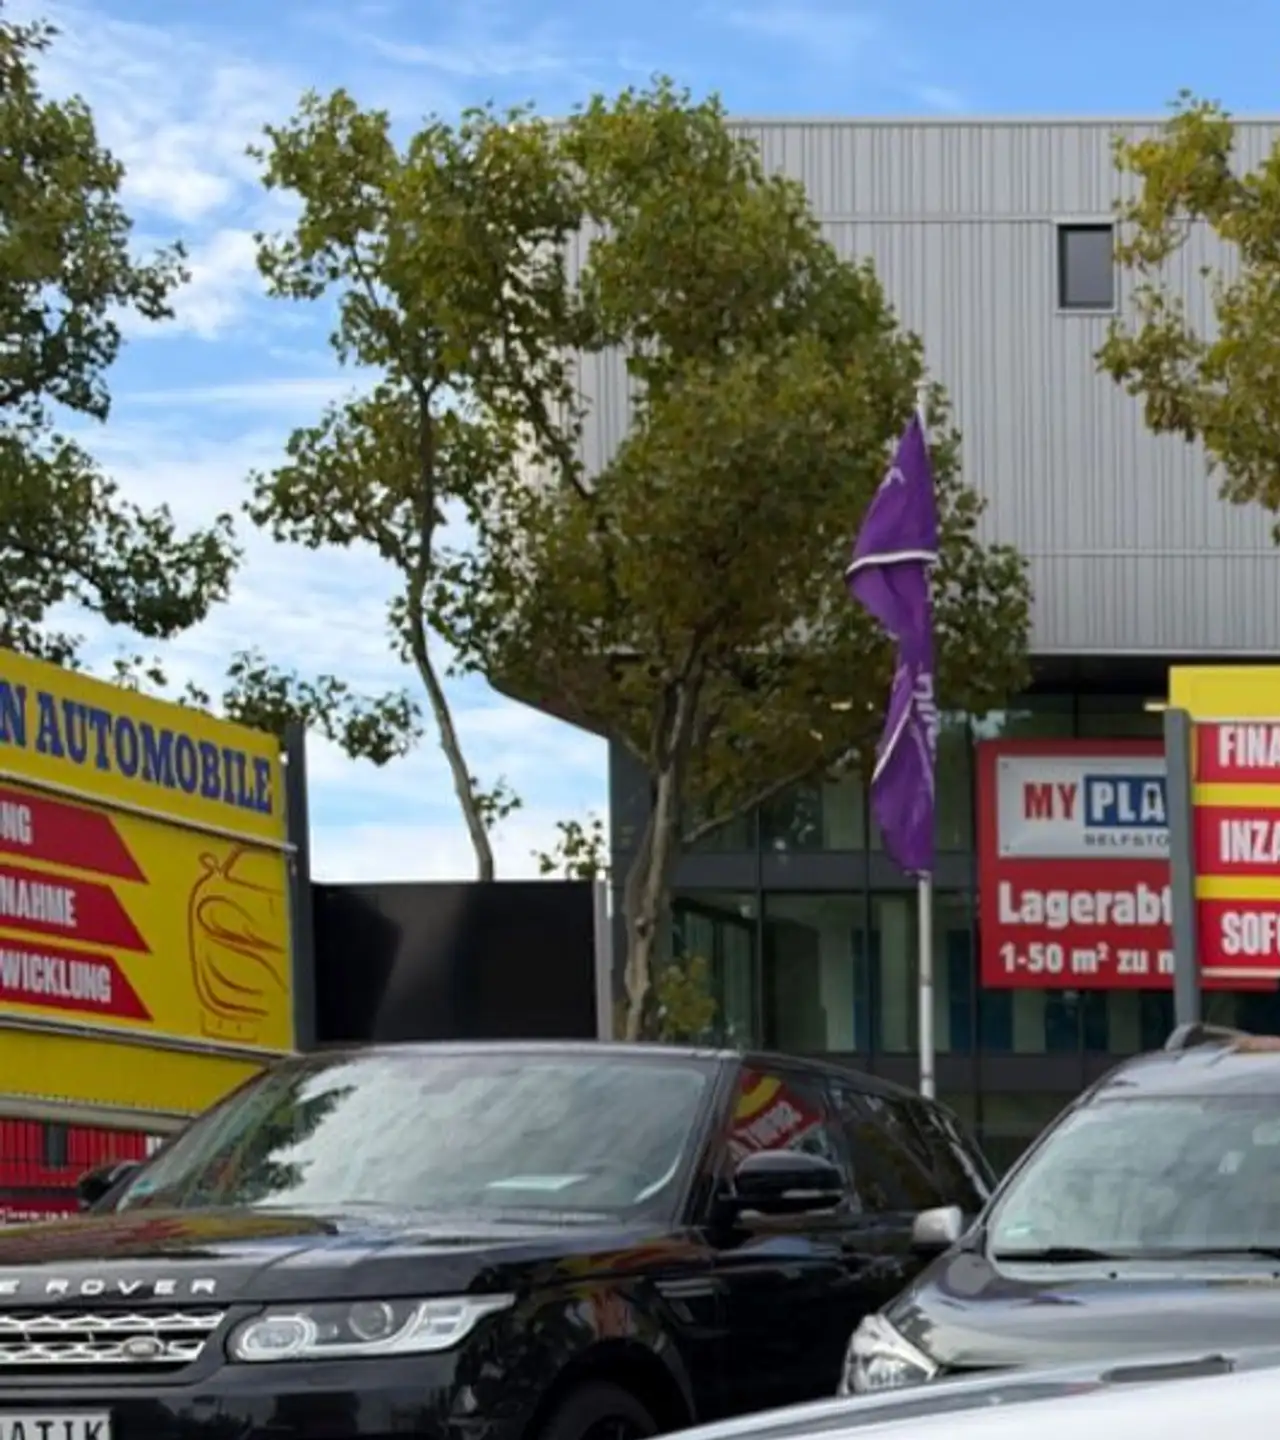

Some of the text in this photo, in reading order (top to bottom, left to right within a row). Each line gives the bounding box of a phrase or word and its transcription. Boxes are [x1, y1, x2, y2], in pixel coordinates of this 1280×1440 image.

[36, 692, 272, 815] AUTOMOBILE
[999, 942, 1063, 973] 1-50
[1117, 949, 1147, 973] zu
[46, 1278, 217, 1296] ROVER
